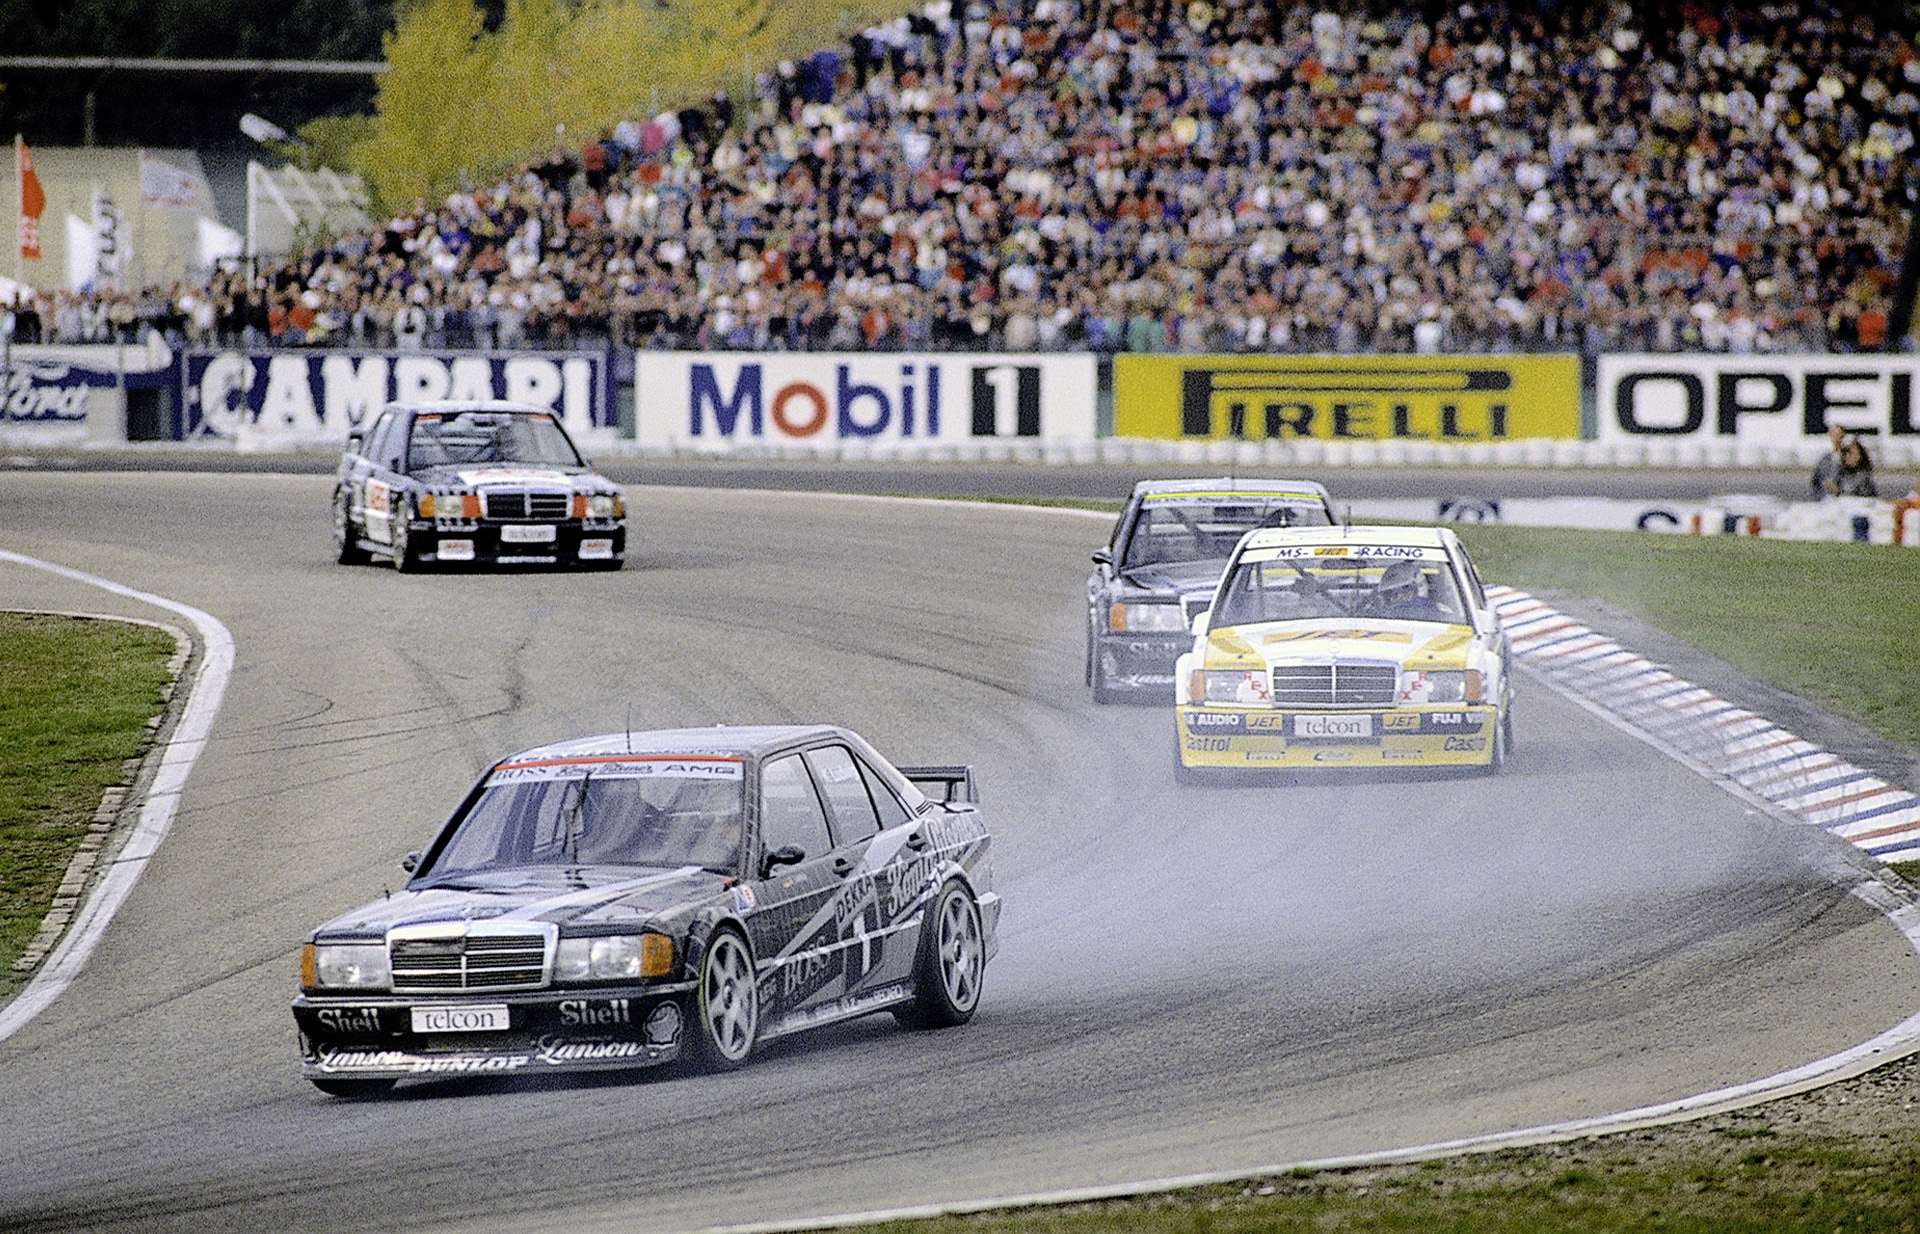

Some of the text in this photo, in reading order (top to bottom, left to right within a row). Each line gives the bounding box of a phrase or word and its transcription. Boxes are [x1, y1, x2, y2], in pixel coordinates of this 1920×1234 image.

[199, 350, 592, 437] CAMPARI
[689, 363, 941, 437] Mobil
[1181, 369, 1511, 438] PIRELLI
[1197, 713, 1240, 726] AUDIO
[1250, 716, 1278, 728] JET
[1306, 716, 1361, 734] telcon
[1386, 716, 1416, 728] JET
[1432, 713, 1462, 725] FUJI
[496, 765, 549, 779] BOSS
[663, 763, 736, 776] AMG
[318, 1008, 381, 1032] Shell
[425, 1009, 496, 1030] telcon
[559, 1000, 630, 1024] Shell
[534, 1033, 643, 1065] Lanson
[408, 1057, 529, 1074] DUNLOP
